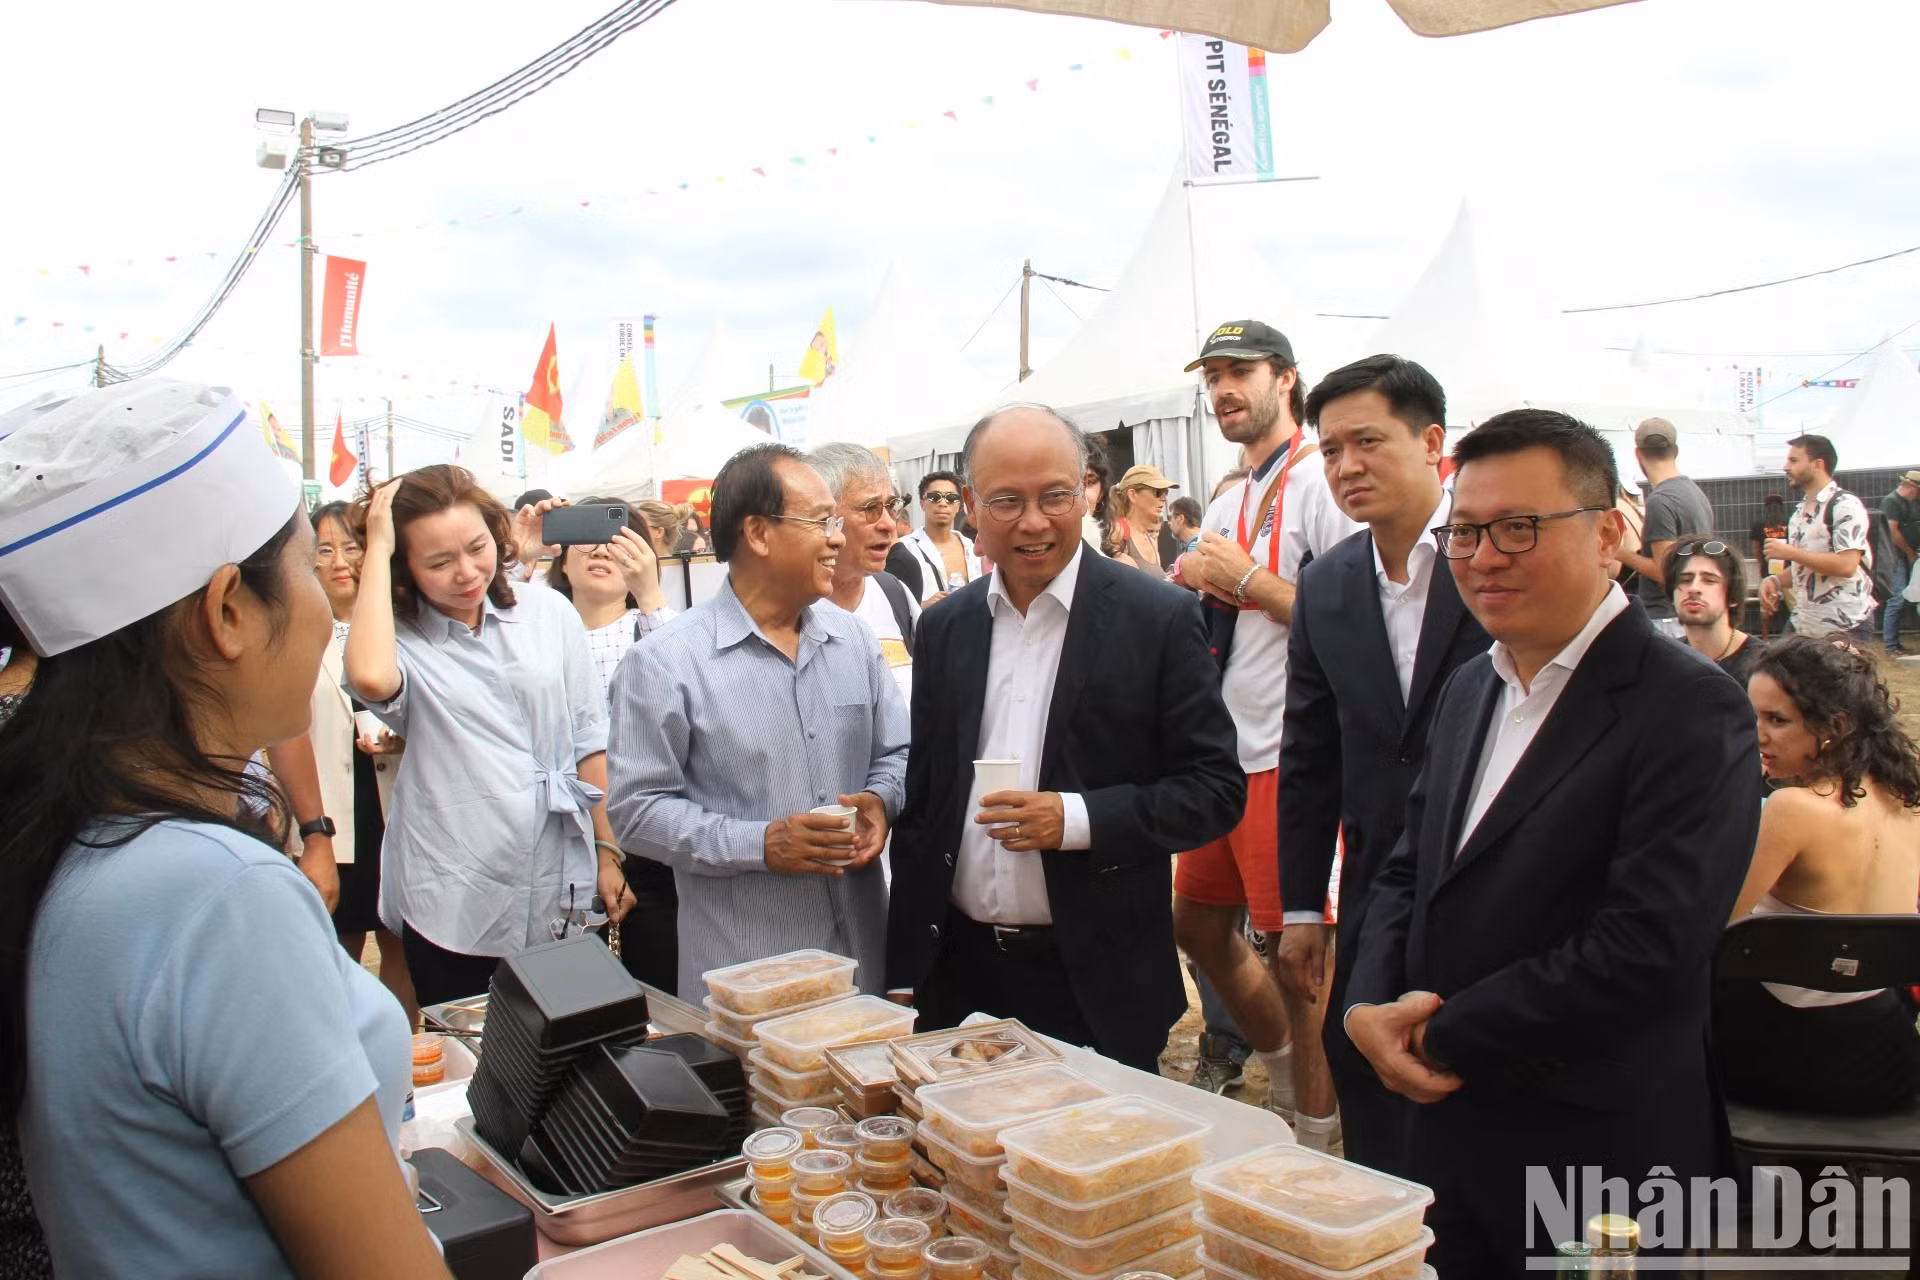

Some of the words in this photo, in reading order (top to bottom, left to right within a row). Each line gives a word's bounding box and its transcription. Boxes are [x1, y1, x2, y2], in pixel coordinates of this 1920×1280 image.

[1205, 40, 1225, 73] PIT
[1207, 79, 1234, 173] SÉNÉGAL
[501, 405, 515, 463] SADI
